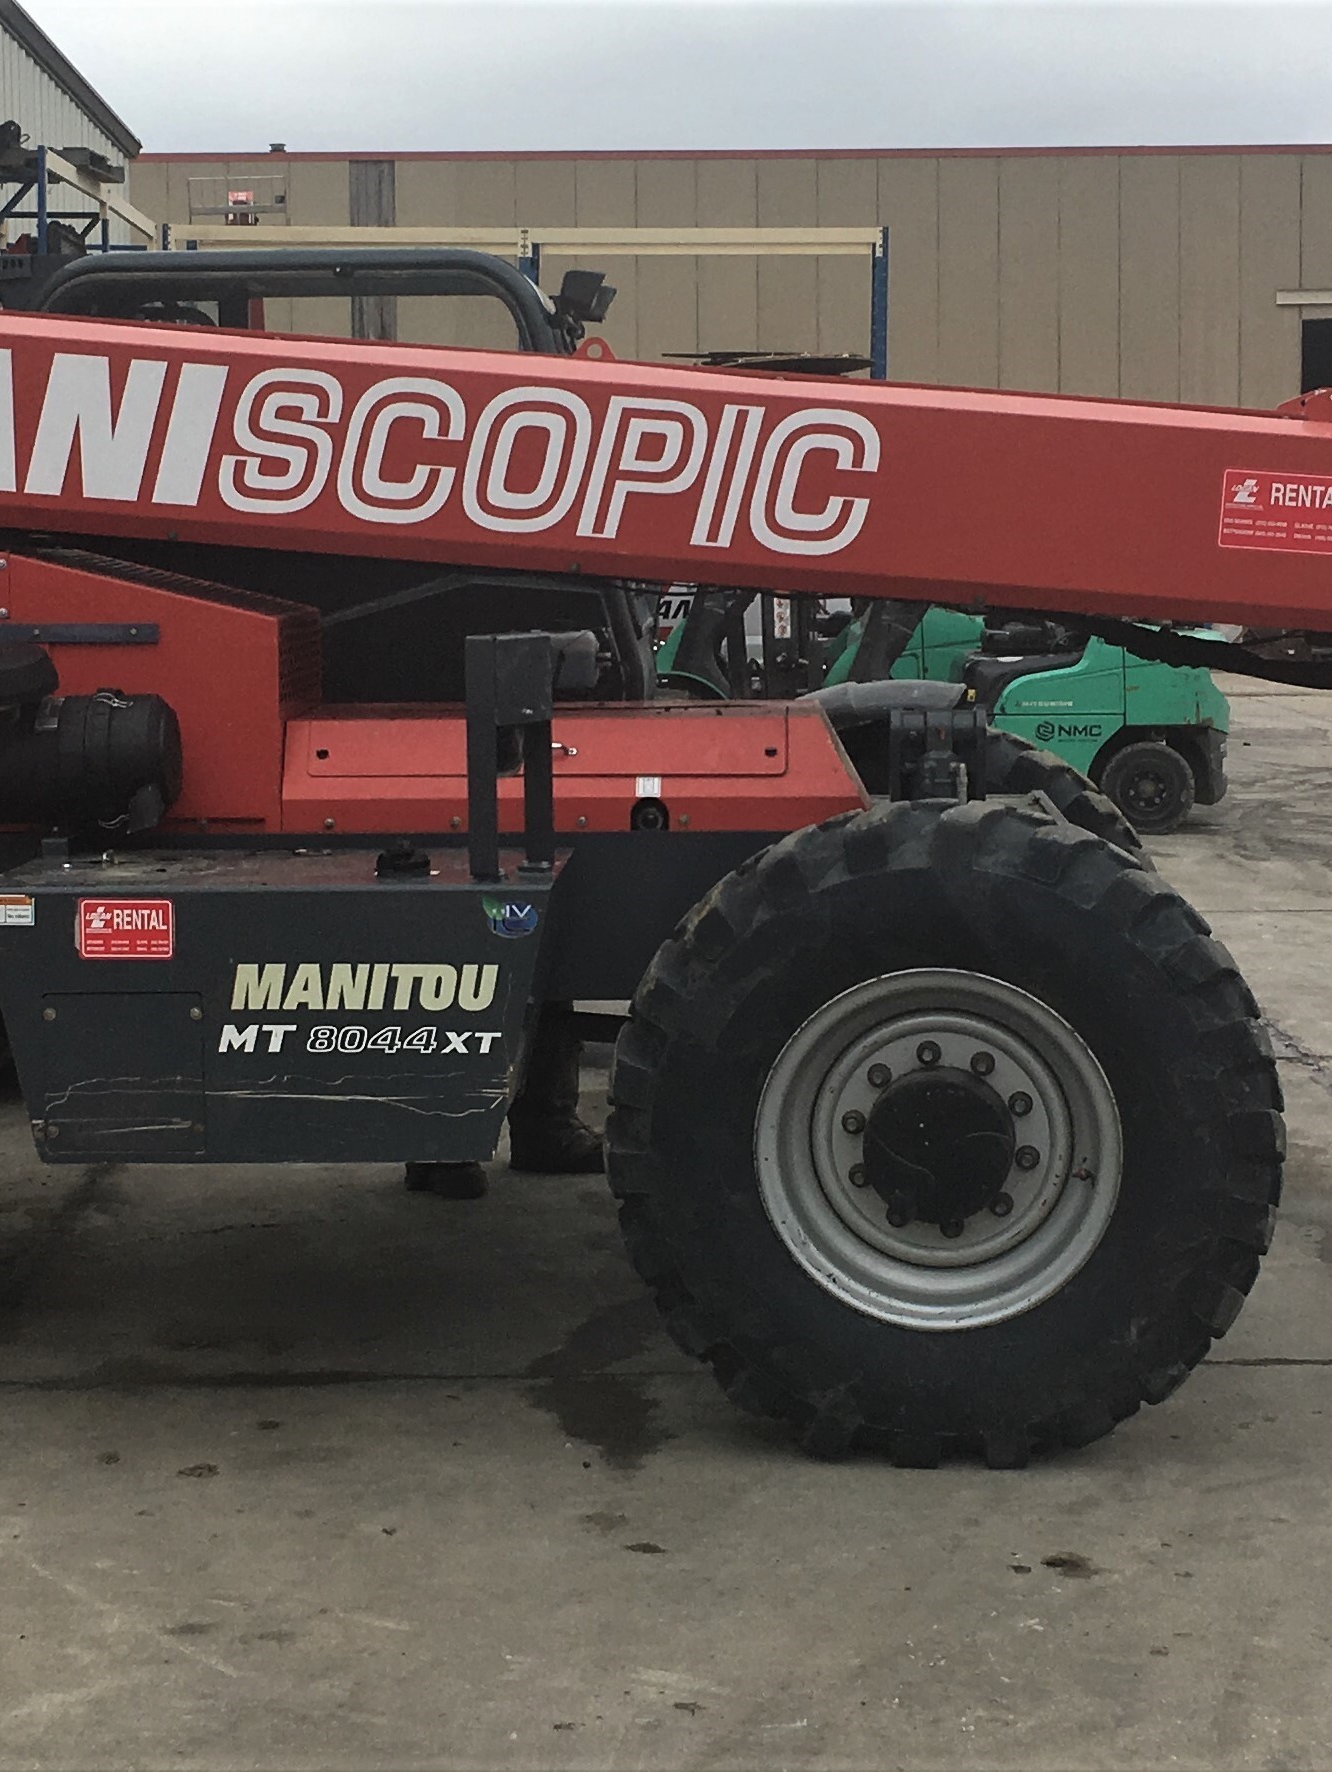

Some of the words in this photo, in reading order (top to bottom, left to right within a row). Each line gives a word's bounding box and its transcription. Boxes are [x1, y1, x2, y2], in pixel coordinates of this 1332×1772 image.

[1057, 724, 1102, 738] NMC
[113, 909, 168, 931] RENTAL
[230, 963, 500, 1012] MANITOU
[218, 1024, 298, 1053] MT
